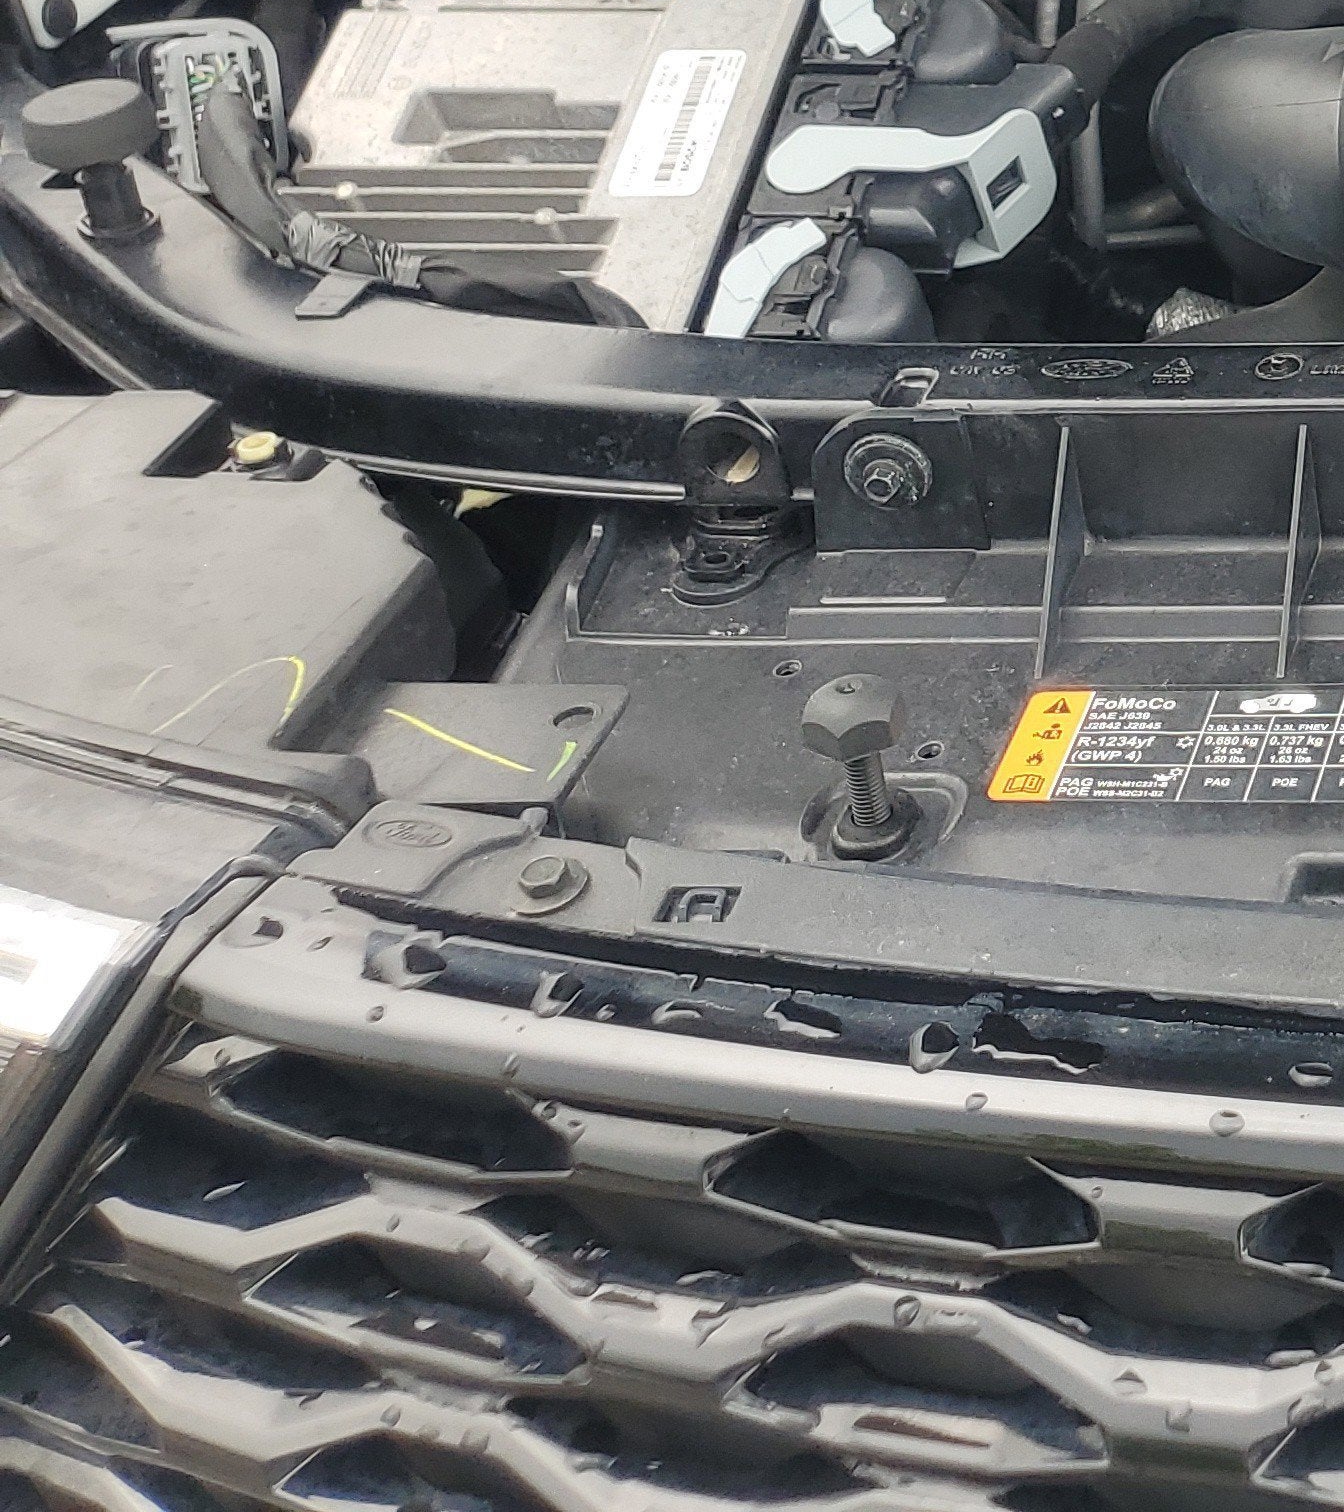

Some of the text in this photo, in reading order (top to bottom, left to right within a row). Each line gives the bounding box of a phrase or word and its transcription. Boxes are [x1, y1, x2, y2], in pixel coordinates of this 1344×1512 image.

[1091, 697, 1177, 710] FoMoCo
[1088, 712, 1151, 720] SAE J639
[1076, 736, 1157, 749] R-1234yf
[1241, 735, 1259, 747] kg
[1269, 735, 1324, 747] 0.737 kg
[1070, 750, 1142, 763] (GWP 4)
[1204, 755, 1246, 763] 1.50 lbs
[1270, 755, 1312, 763] 1.63 lbs
[1059, 777, 1094, 787] PAG
[1204, 777, 1231, 787] PAG
[1271, 777, 1299, 787] POE
[1055, 787, 1091, 797] POE
